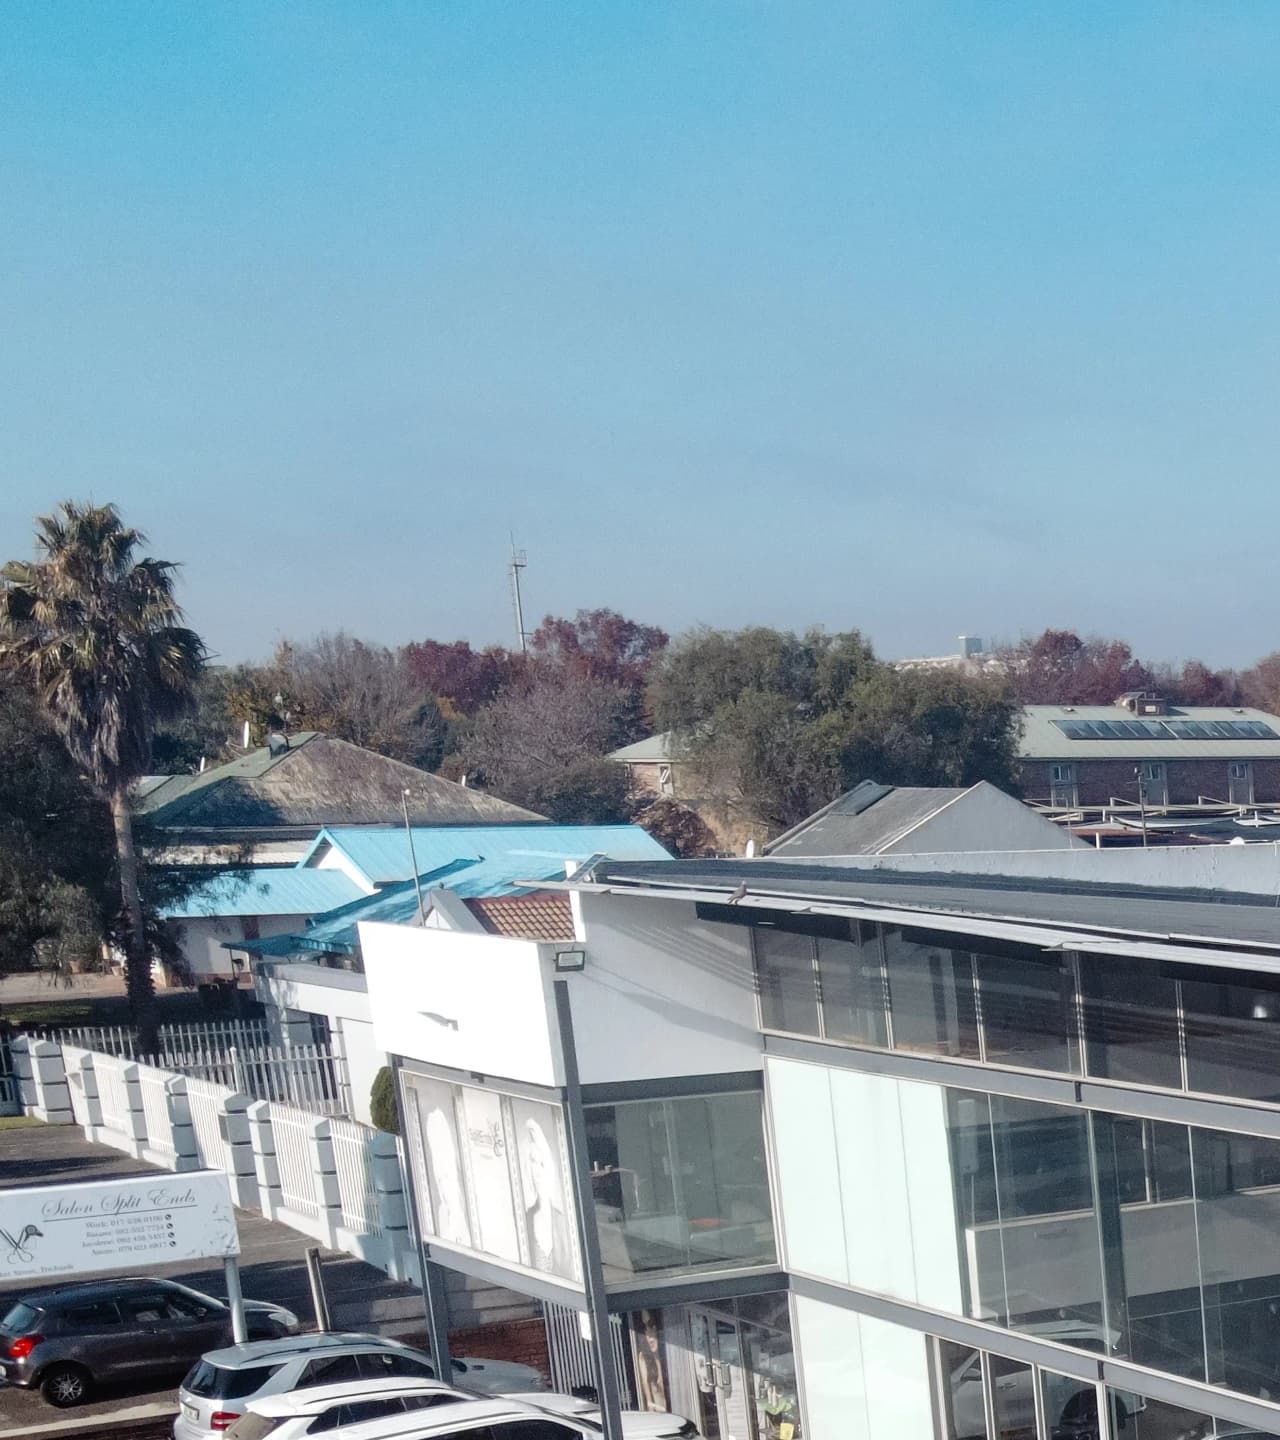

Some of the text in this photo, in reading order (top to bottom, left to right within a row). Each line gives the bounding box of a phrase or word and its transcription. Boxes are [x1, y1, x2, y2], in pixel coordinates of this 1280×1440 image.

[42, 1188, 197, 1217] Salon Split Ends
